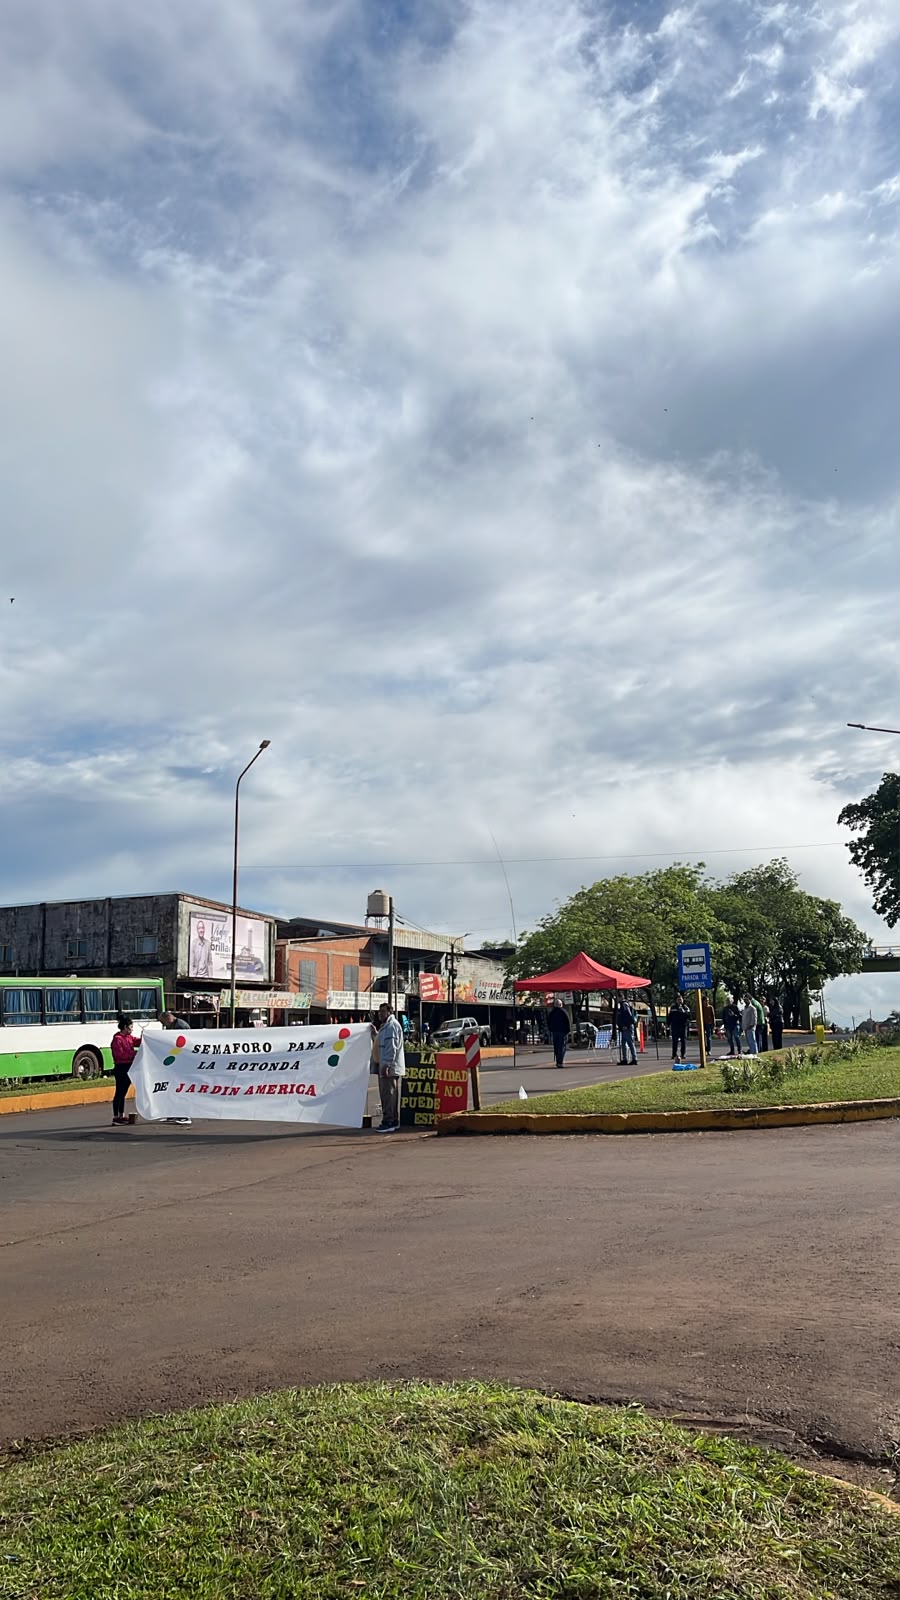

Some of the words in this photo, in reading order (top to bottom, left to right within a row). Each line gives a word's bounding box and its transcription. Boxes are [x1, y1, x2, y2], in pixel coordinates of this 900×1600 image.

[210, 942, 231, 953] brilla
[479, 979, 503, 989] Supermer
[474, 988, 487, 999] Los
[267, 998, 289, 1007] LUCES
[191, 1041, 272, 1055] SEMAFORO
[287, 1041, 325, 1053] PARA
[420, 1053, 436, 1065] LA
[197, 1060, 215, 1070] LA
[226, 1060, 301, 1072] ROTONDA
[402, 1067, 468, 1083] SEGURIDAD
[152, 1081, 169, 1093] DE
[175, 1082, 240, 1096] JARDIN
[243, 1082, 317, 1097] AMERICA
[407, 1082, 439, 1094] VIAL
[444, 1085, 463, 1097] NO
[401, 1096, 441, 1110] PUEDE
[414, 1112, 448, 1125] ESPE
